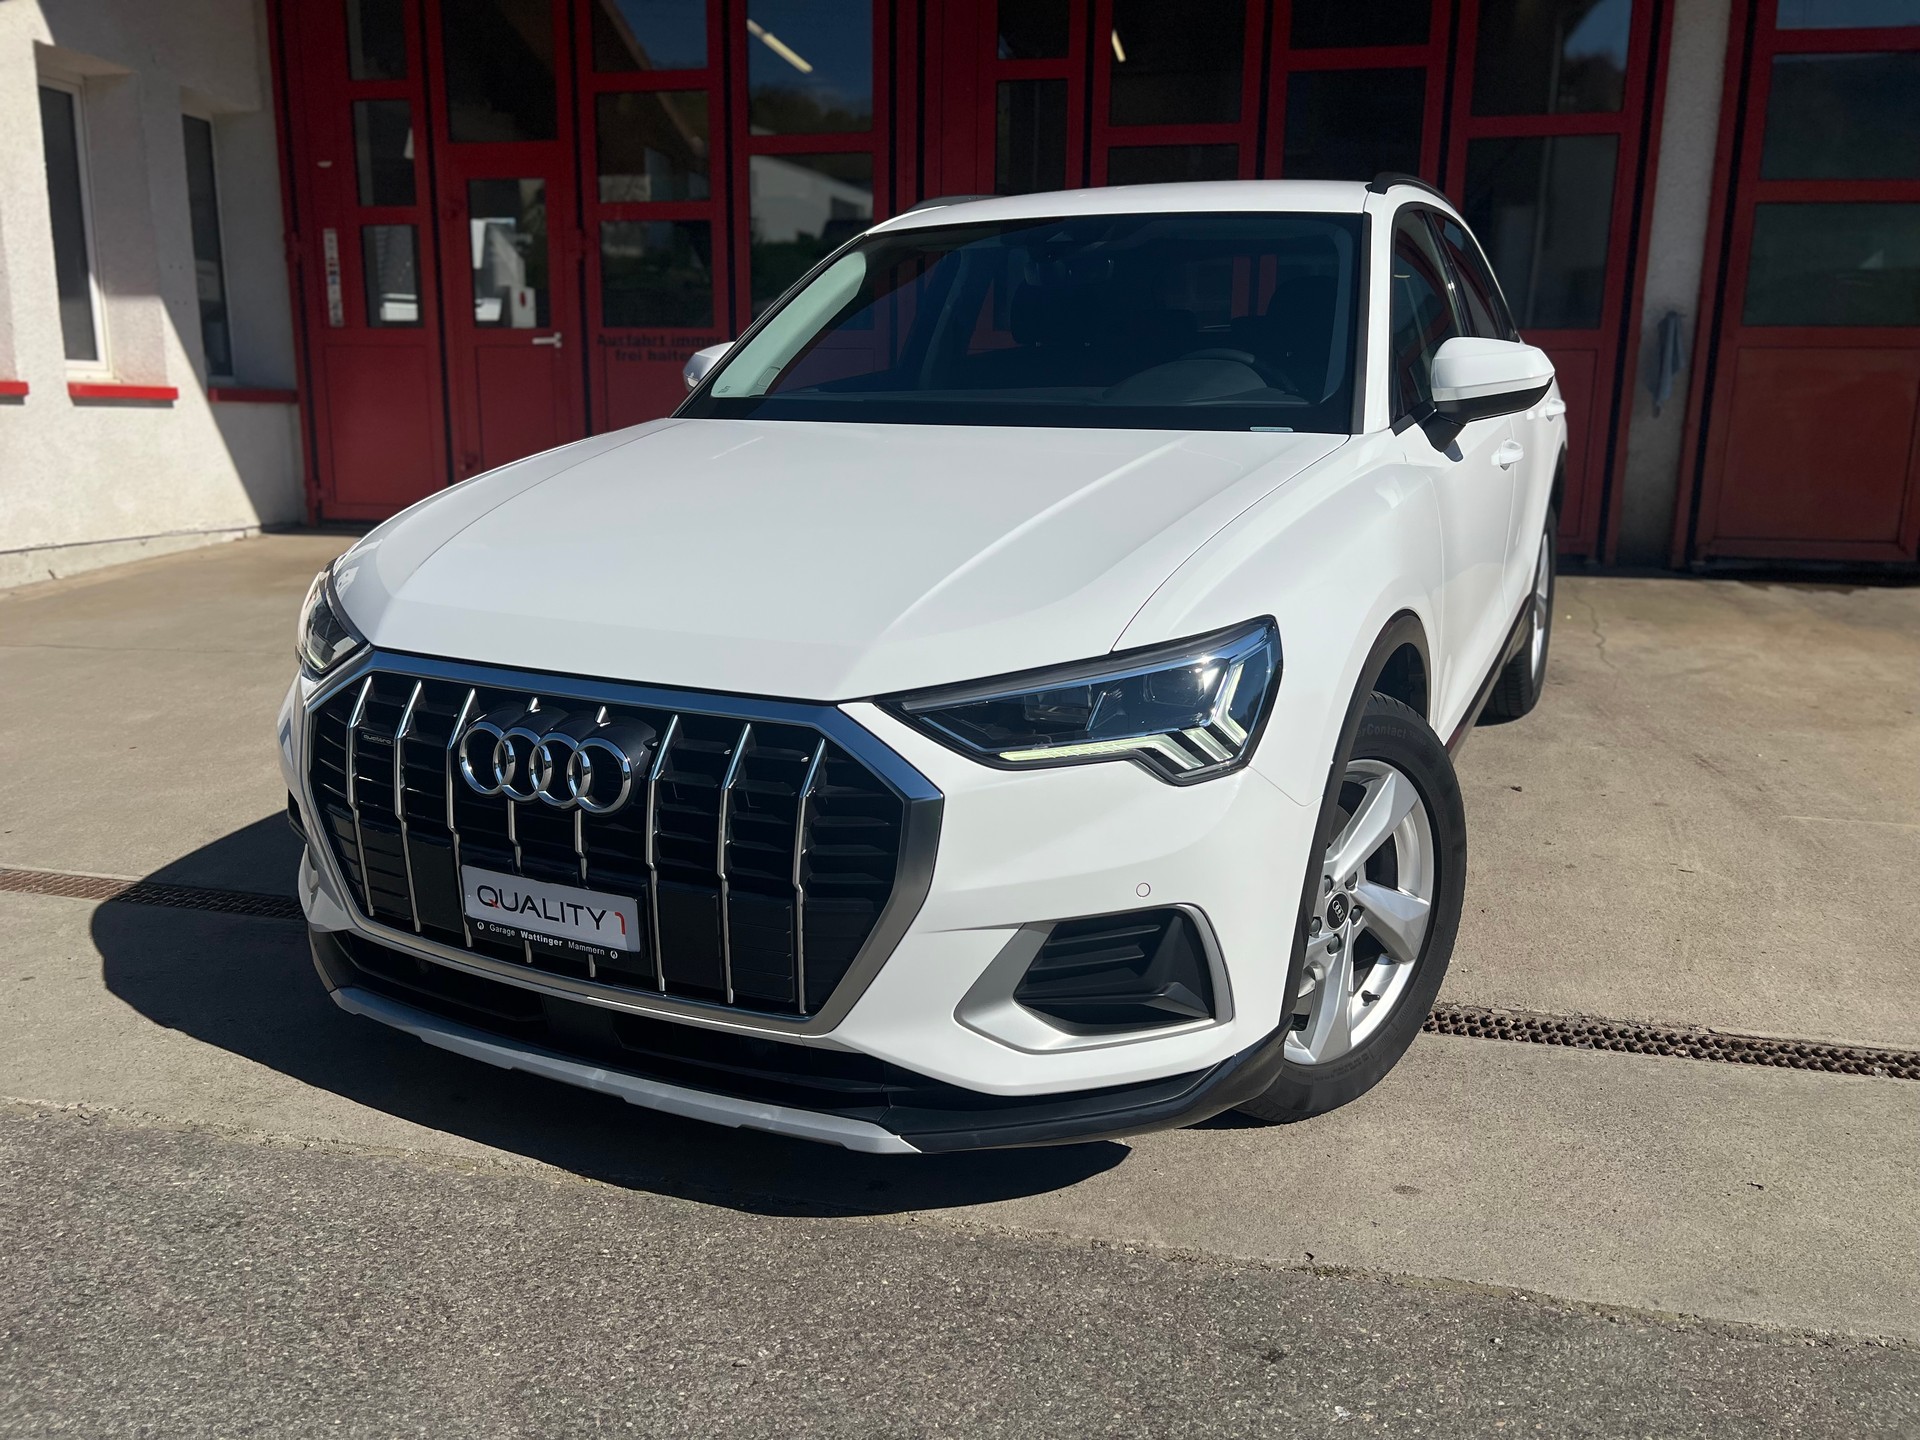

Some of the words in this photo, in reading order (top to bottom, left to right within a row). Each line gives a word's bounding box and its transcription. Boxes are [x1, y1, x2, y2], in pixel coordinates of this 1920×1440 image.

[489, 923, 516, 937] Garage
[520, 930, 563, 947] Wattinger
[568, 941, 605, 956] Mammern
